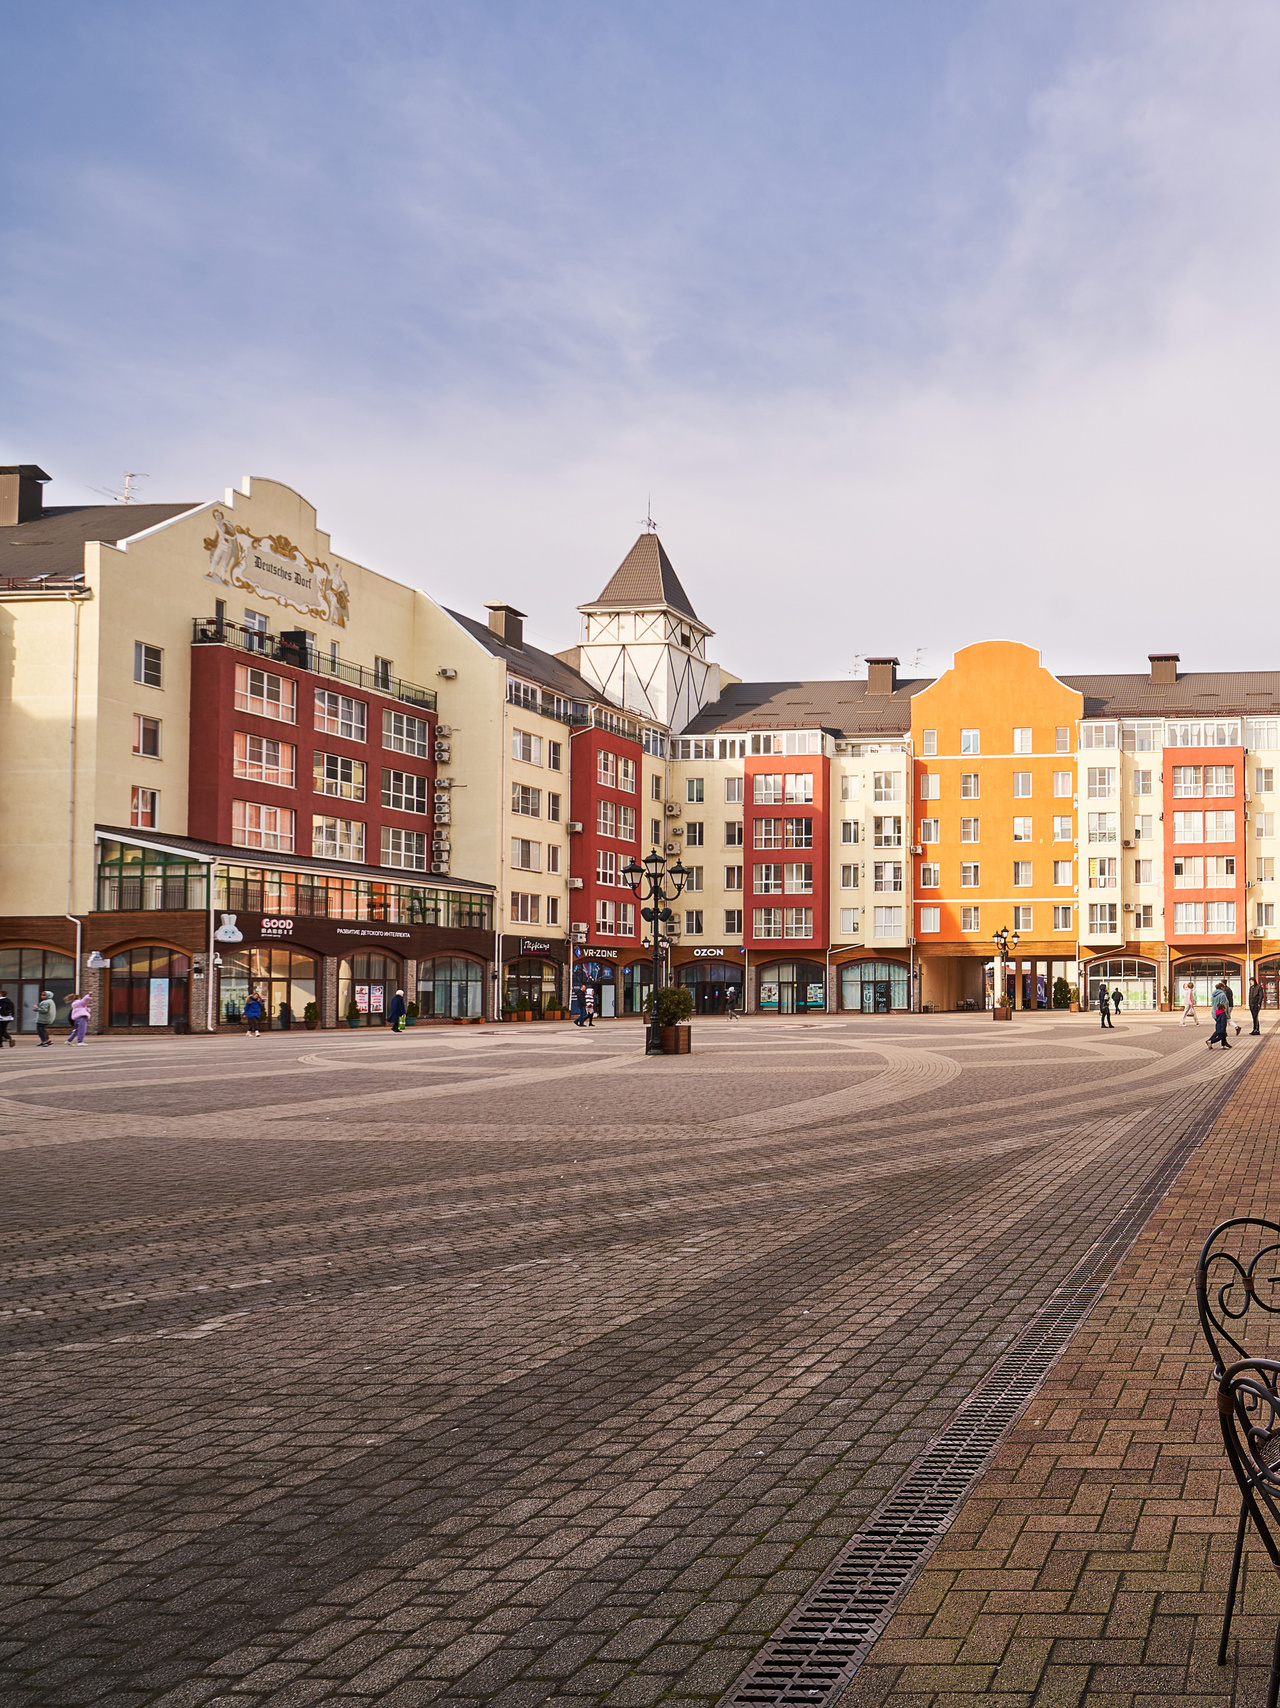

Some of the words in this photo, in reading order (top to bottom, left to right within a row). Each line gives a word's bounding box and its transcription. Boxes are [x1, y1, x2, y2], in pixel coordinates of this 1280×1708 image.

[254, 555, 292, 581] Deutsches
[294, 571, 313, 590] Dorf
[261, 918, 294, 929] GOOD
[336, 928, 360, 936] РАЗВИТИЕ
[360, 929, 384, 937] ДЕТСКОГО
[583, 949, 618, 958] VR-ZONE
[693, 948, 724, 957] OZON
